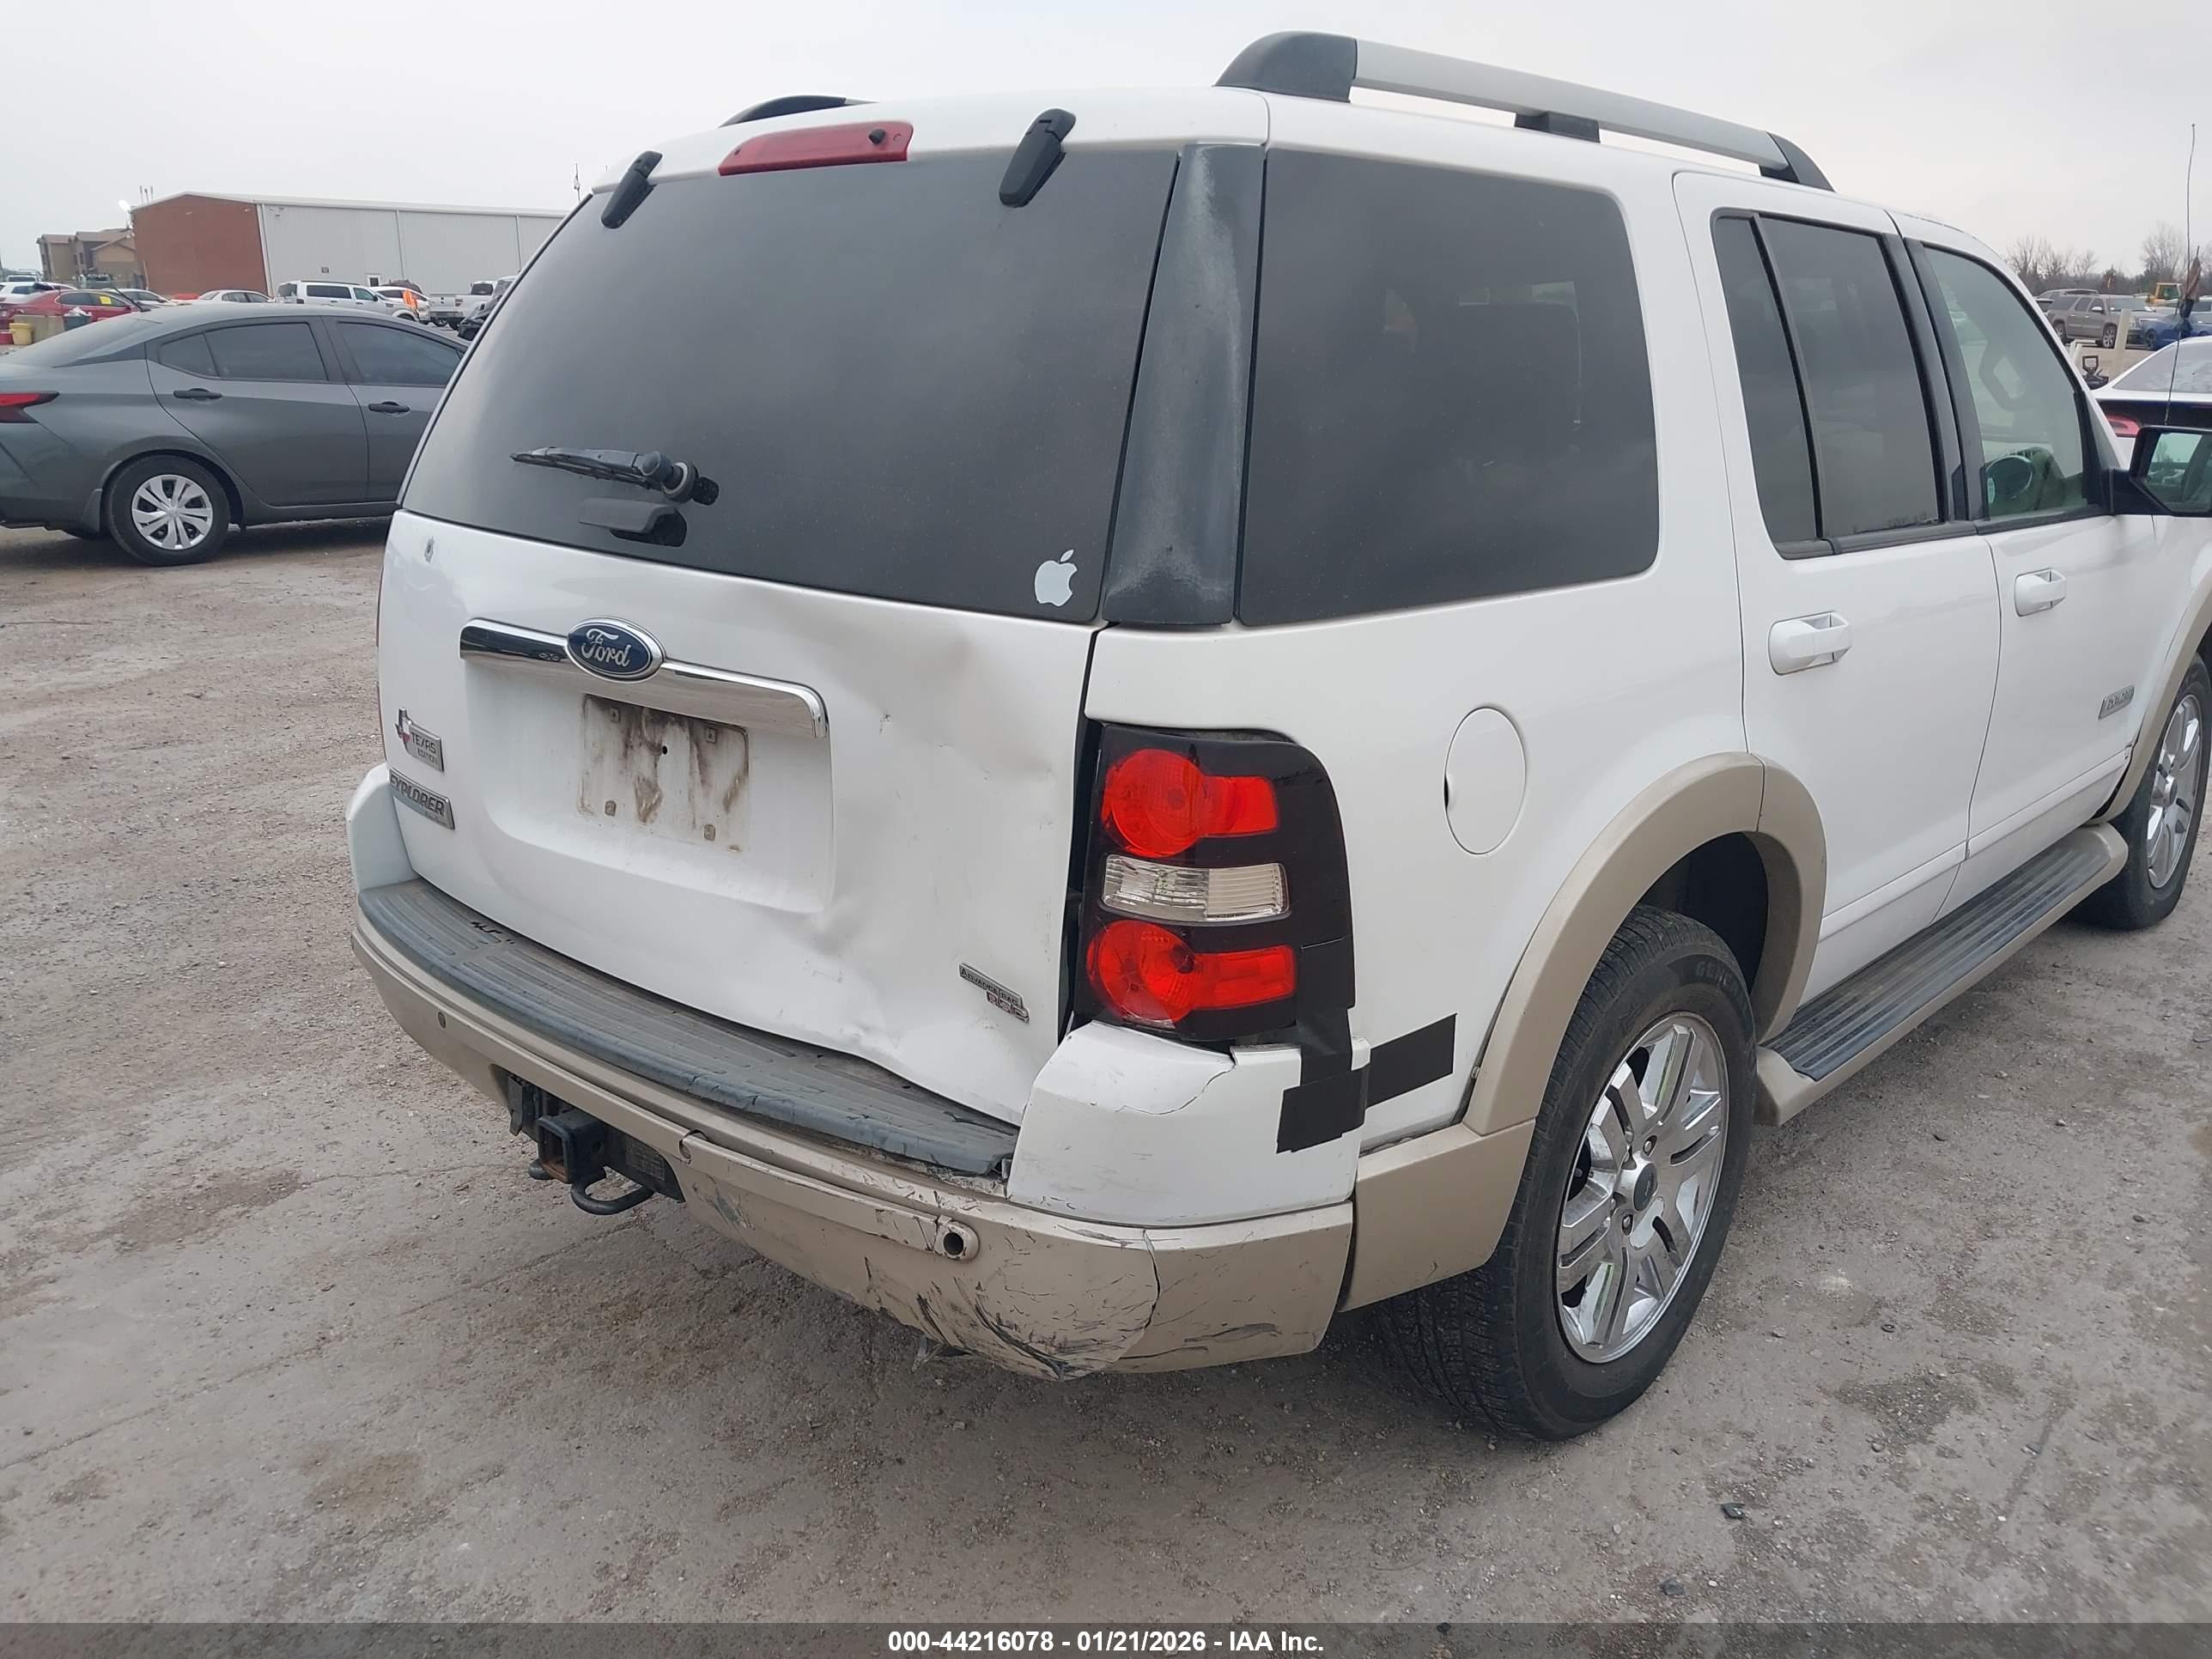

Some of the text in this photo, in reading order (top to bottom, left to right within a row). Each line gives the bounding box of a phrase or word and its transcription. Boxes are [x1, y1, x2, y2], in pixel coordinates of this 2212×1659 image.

[580, 628, 632, 667] Ford
[411, 732, 436, 755] TEXAS
[391, 774, 445, 817] EXPLORER
